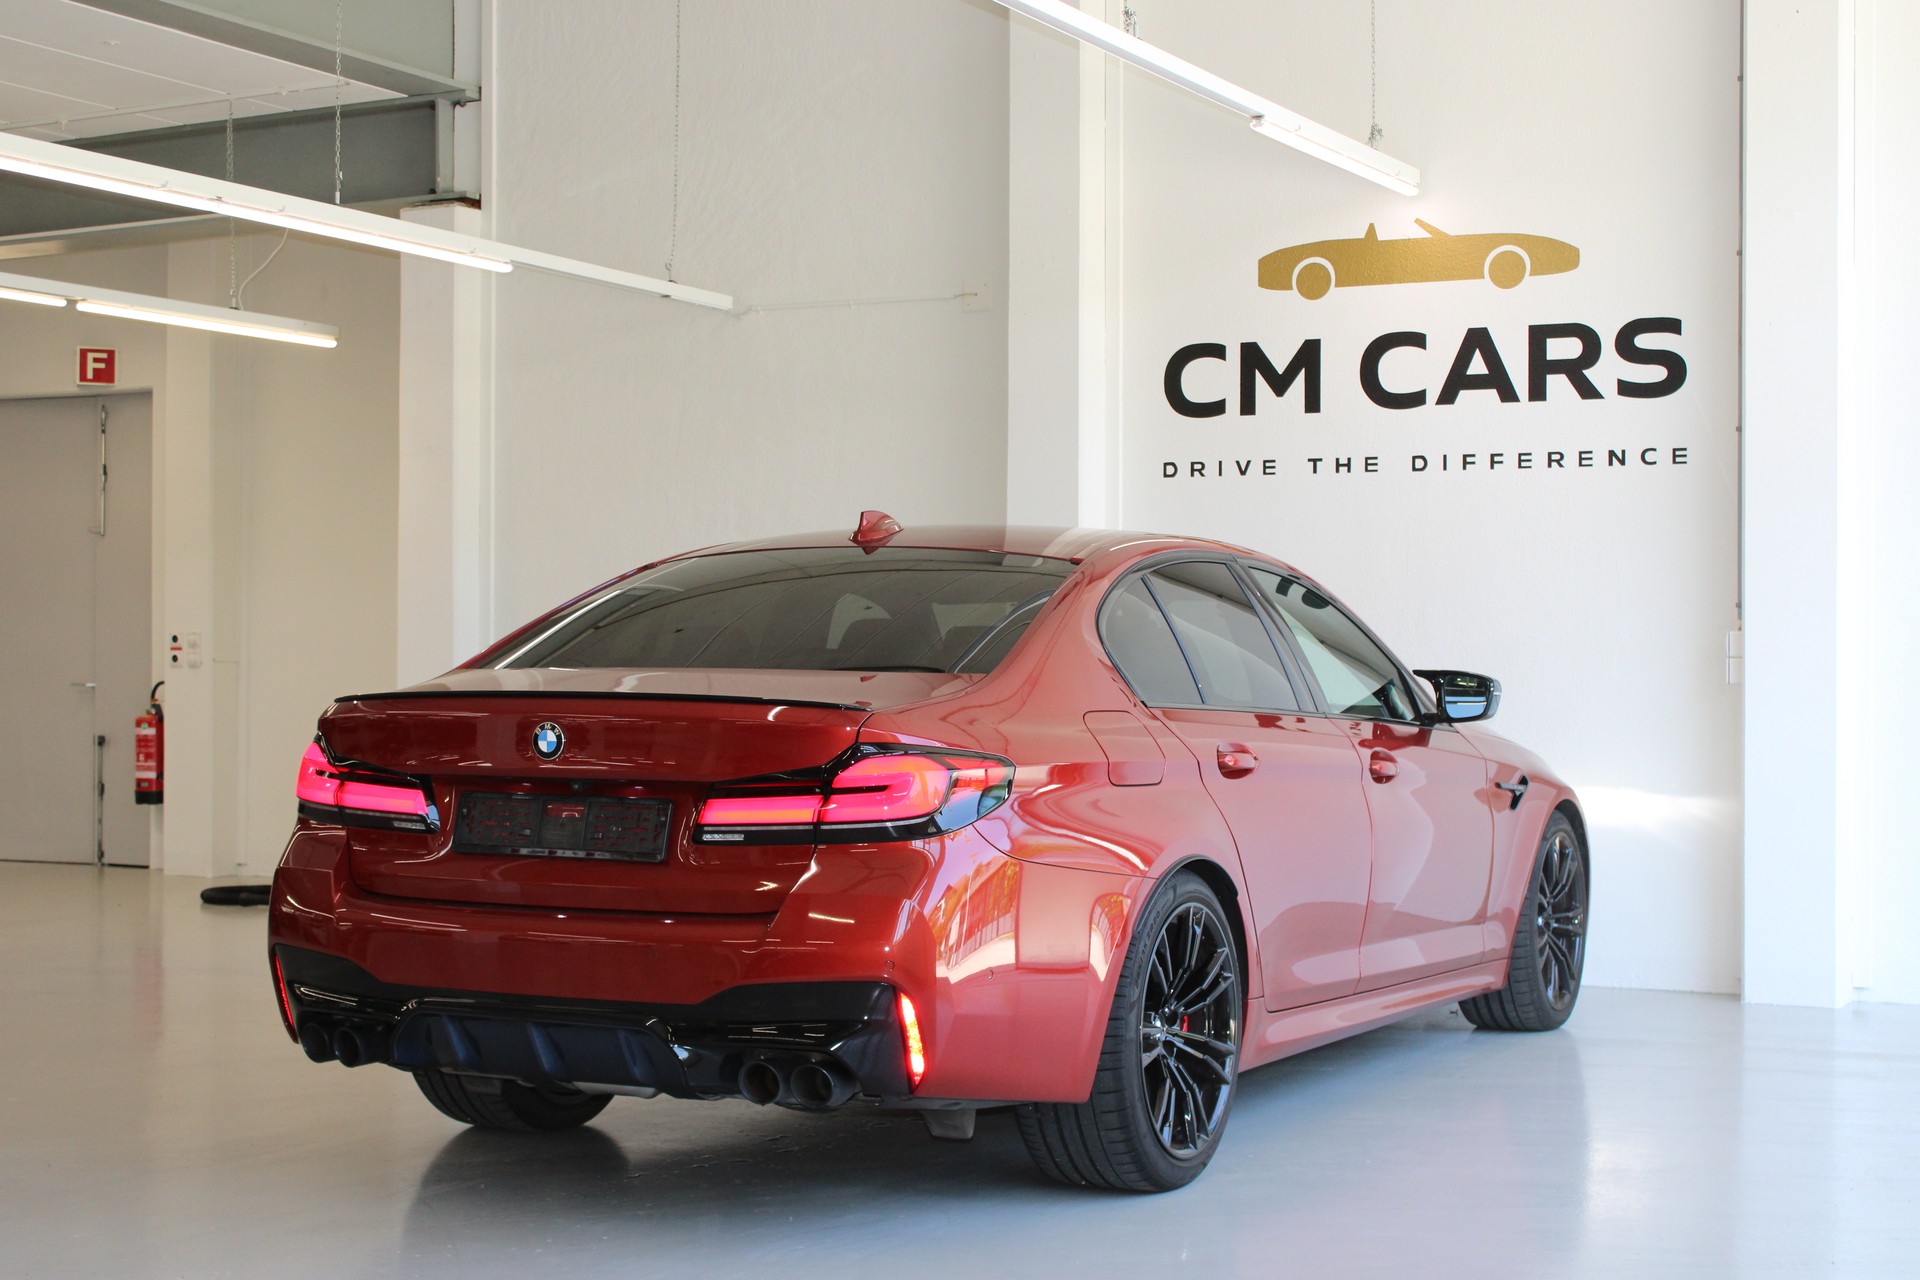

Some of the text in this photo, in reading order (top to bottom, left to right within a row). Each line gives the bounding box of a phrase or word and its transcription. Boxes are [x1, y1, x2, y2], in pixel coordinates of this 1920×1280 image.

[86, 352, 108, 380] F
[1164, 316, 1688, 419] CM CARS
[1163, 447, 1688, 478] DRIVE THE DIFFERENCE
[536, 723, 561, 736] BMW
